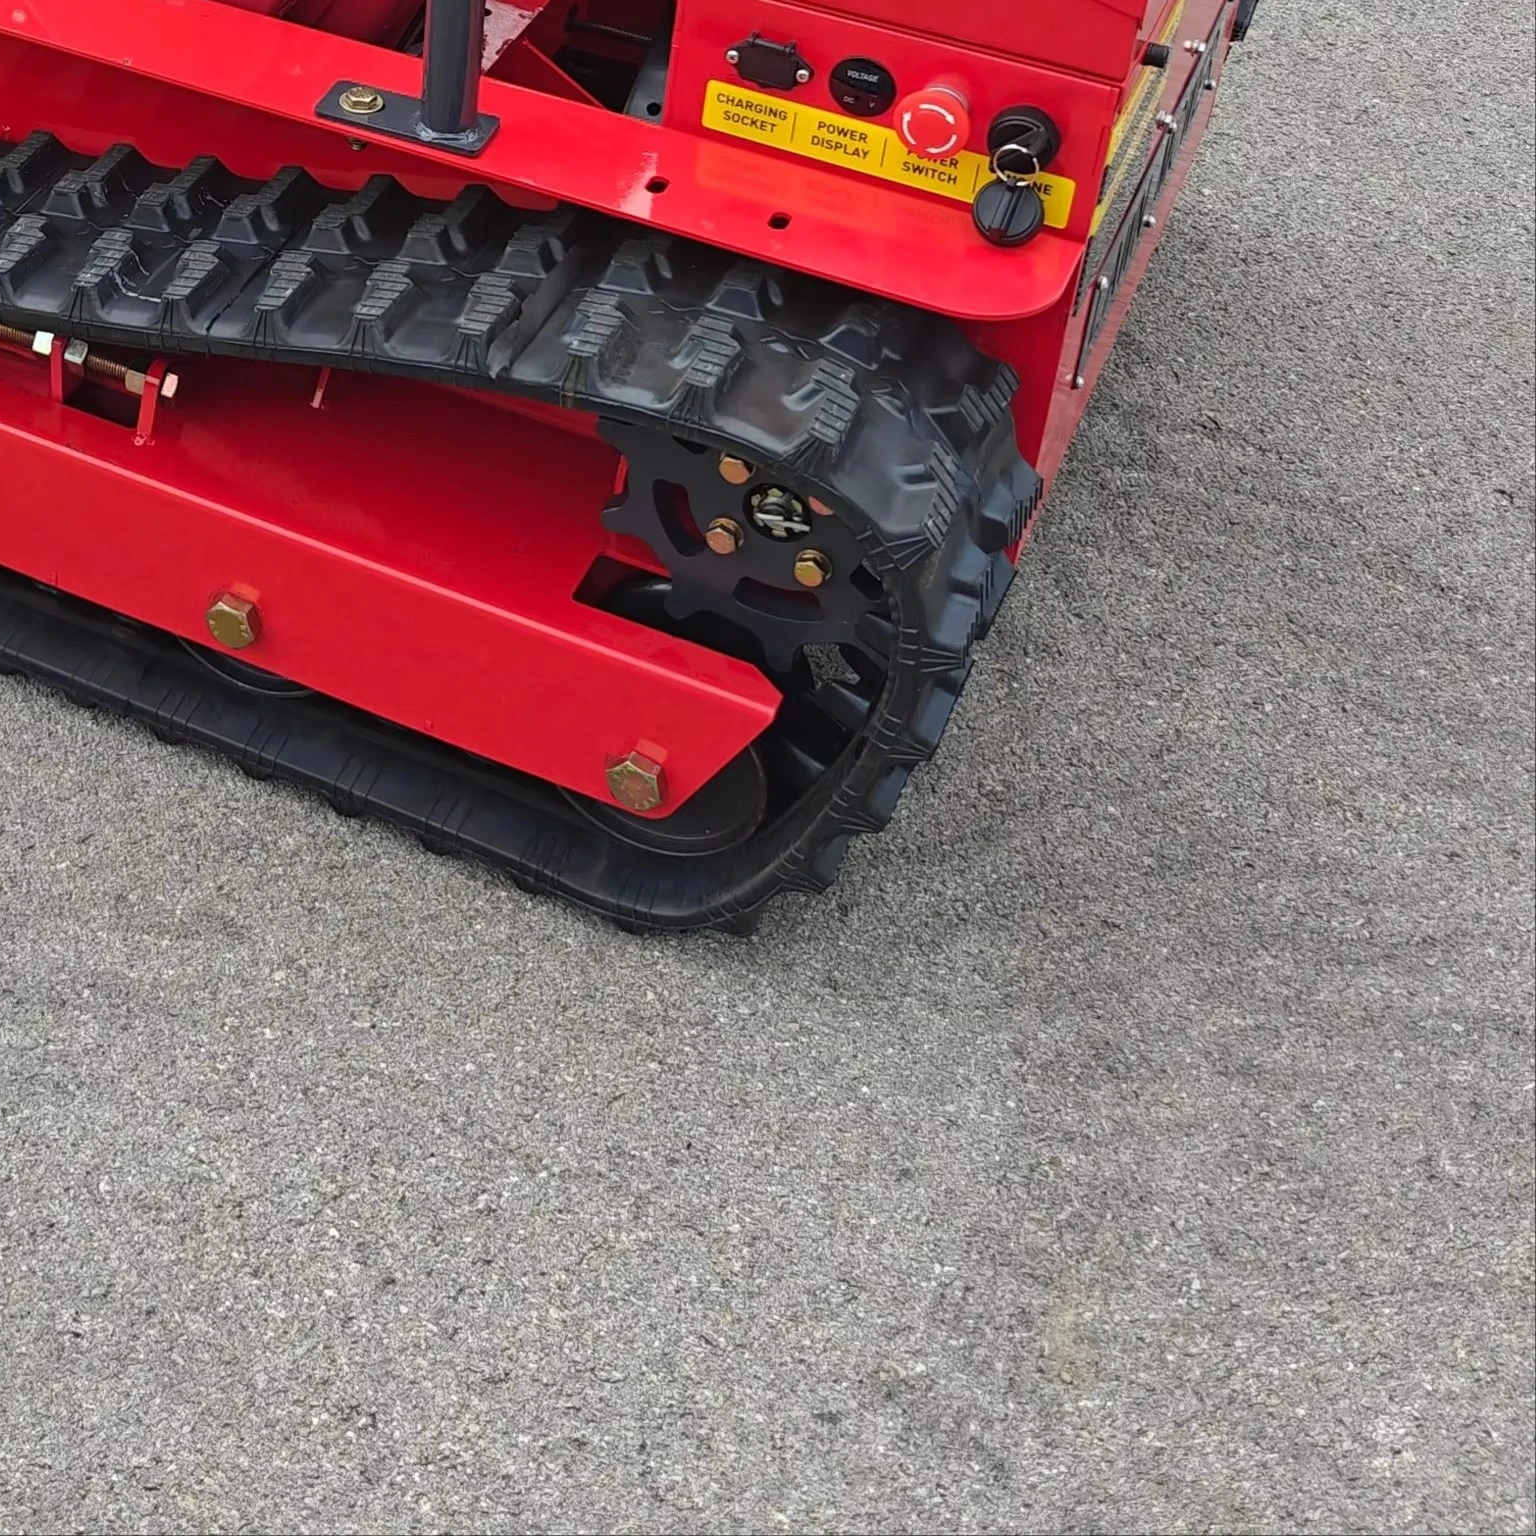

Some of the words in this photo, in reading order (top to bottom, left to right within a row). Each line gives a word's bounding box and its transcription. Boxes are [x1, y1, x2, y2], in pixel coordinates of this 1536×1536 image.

[847, 69, 880, 83] VOLTAGE
[716, 92, 788, 121] CHARGING
[843, 95, 855, 104] DC
[868, 100, 876, 108] V
[722, 110, 777, 134] SOCKET
[817, 120, 869, 144] POWER
[810, 135, 870, 160] DISPLAY
[901, 160, 958, 186] SWITCH
